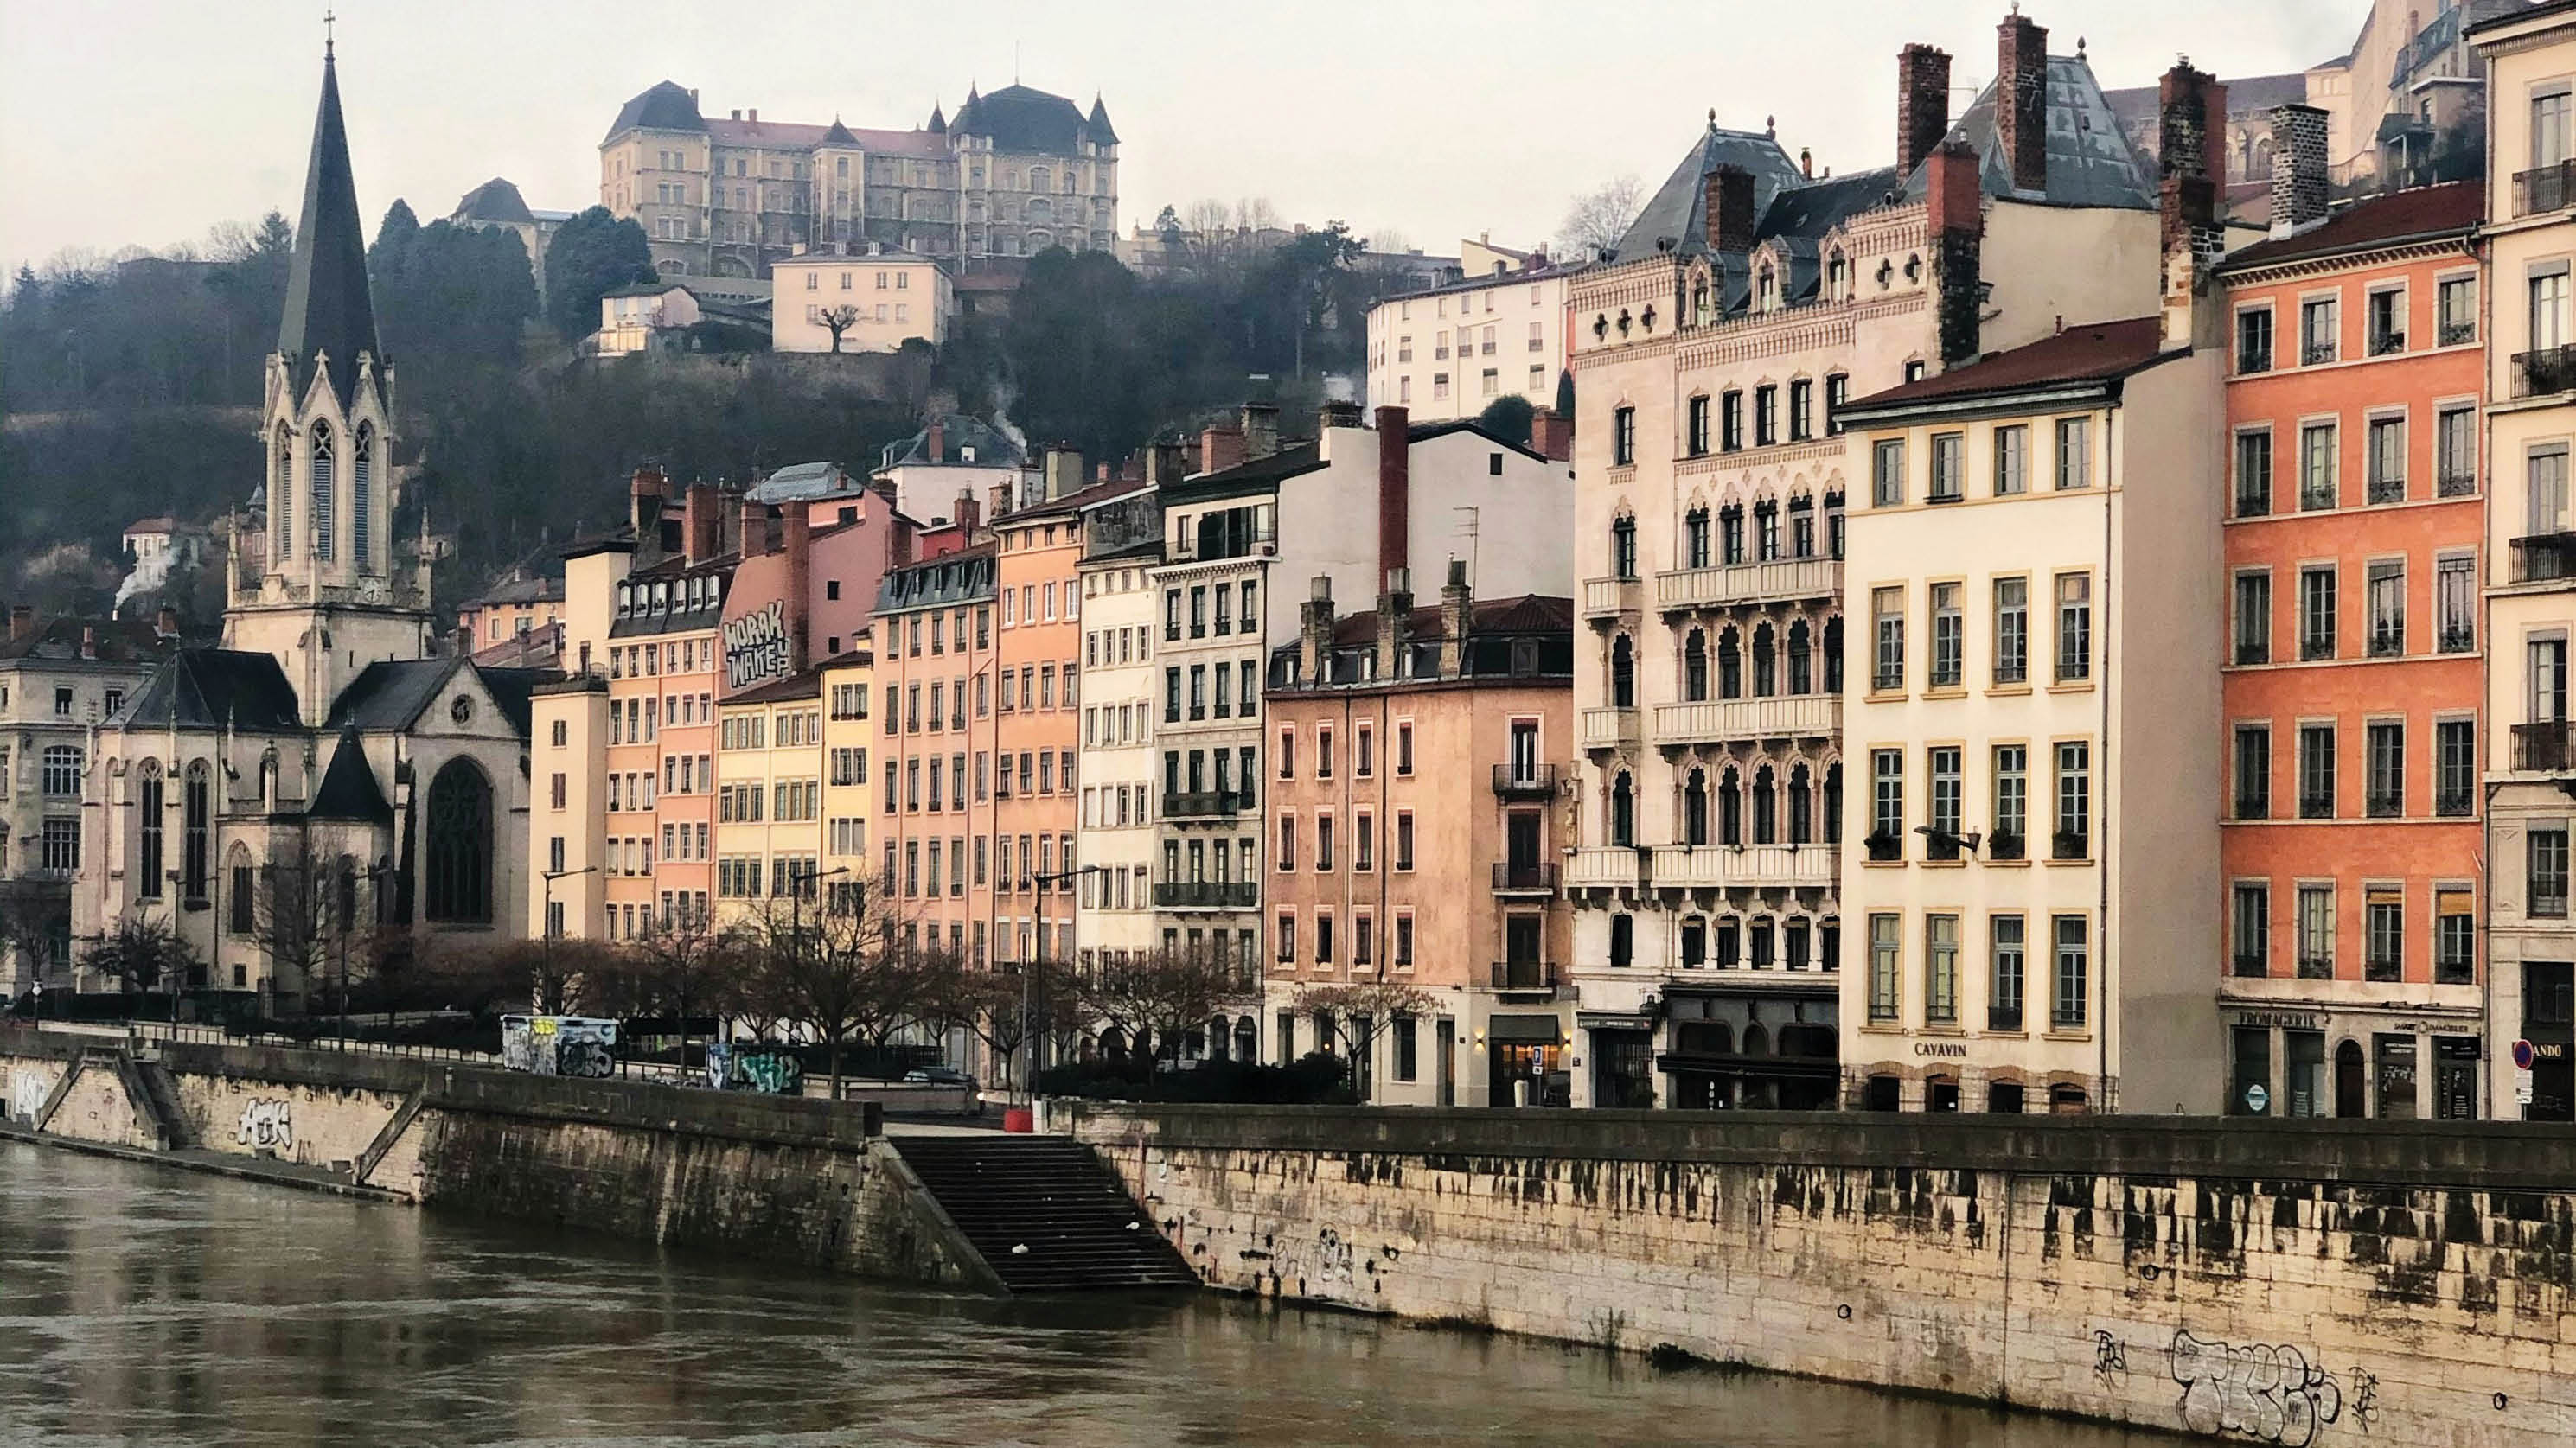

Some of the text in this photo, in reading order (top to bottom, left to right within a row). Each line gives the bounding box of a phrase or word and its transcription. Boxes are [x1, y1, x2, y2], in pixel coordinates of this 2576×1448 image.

[727, 644, 777, 687] WAKE
[1914, 1042, 1966, 1057] CAVAVIN
[2533, 1044, 2562, 1057] ANDO
